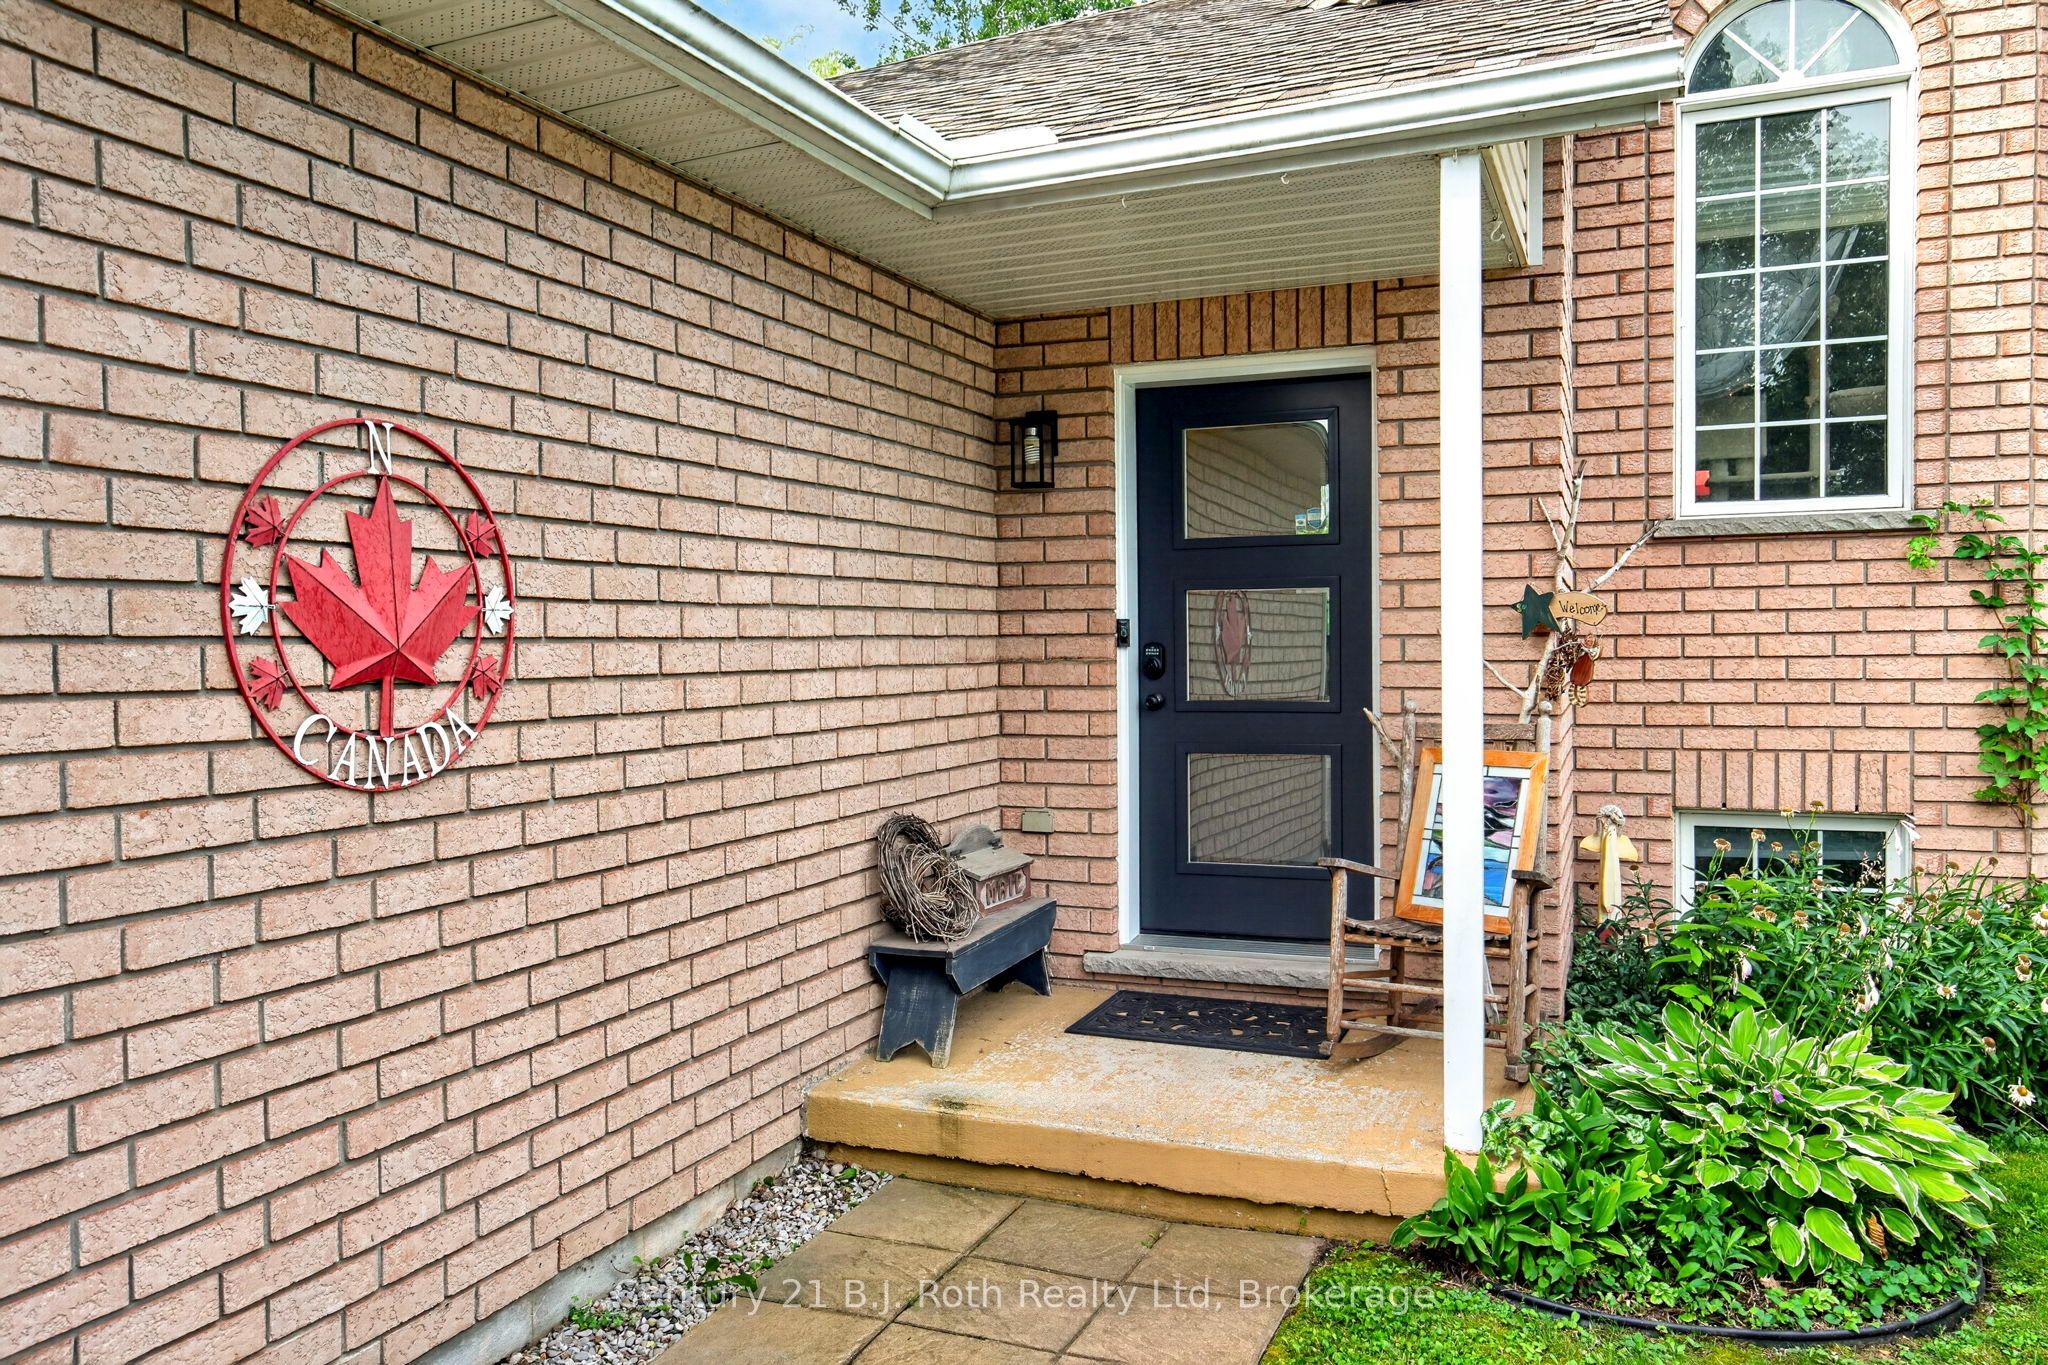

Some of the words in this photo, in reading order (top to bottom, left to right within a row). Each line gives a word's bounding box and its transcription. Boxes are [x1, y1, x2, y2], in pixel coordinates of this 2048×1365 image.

[365, 420, 394, 475] N
[1558, 600, 1601, 615] Welcome
[293, 707, 479, 790] CANADA
